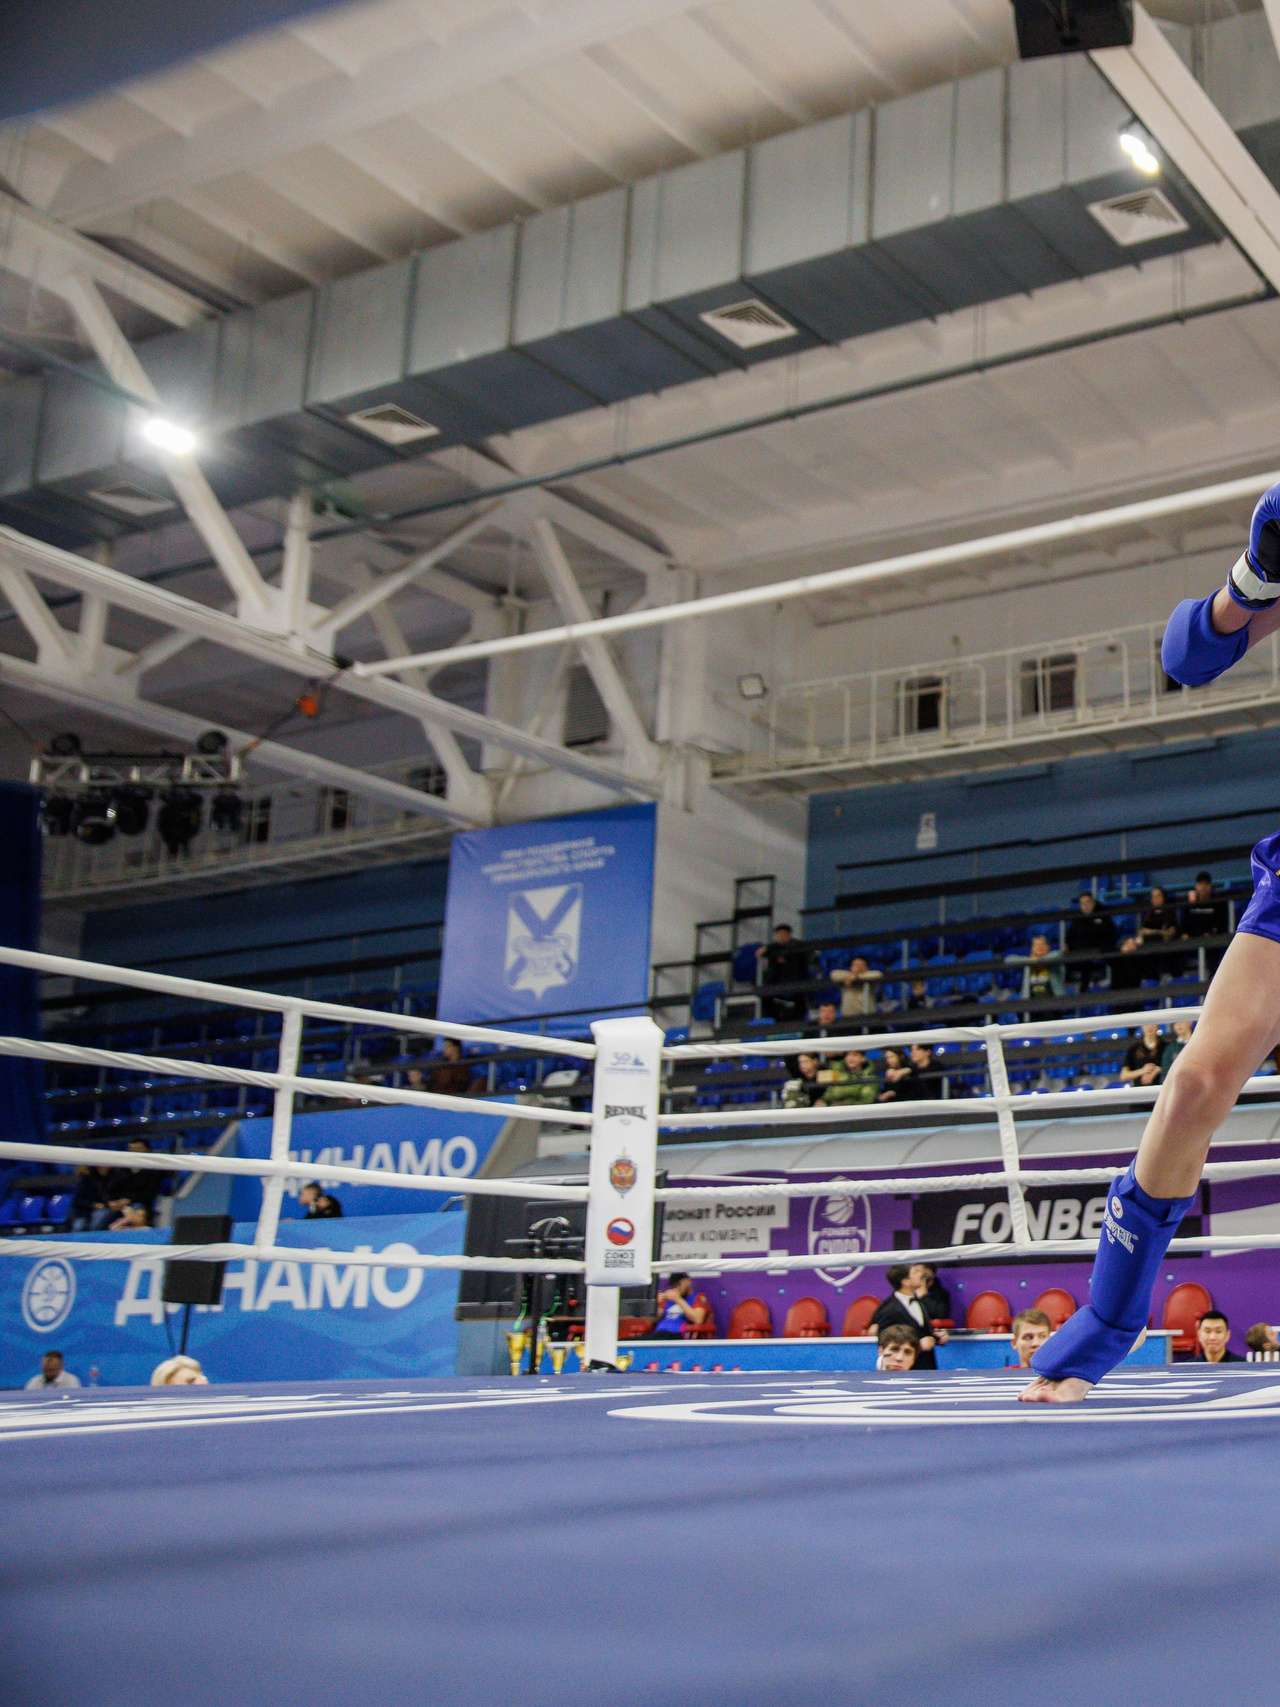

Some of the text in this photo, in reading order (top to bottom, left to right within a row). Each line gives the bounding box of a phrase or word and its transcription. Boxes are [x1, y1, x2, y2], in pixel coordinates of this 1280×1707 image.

[604, 1104, 648, 1120] REWEL
[715, 1203, 776, 1218] России
[951, 1196, 1110, 1246] FONBE
[700, 1228, 758, 1242] команд
[114, 1242, 424, 1327] ДНАМО
